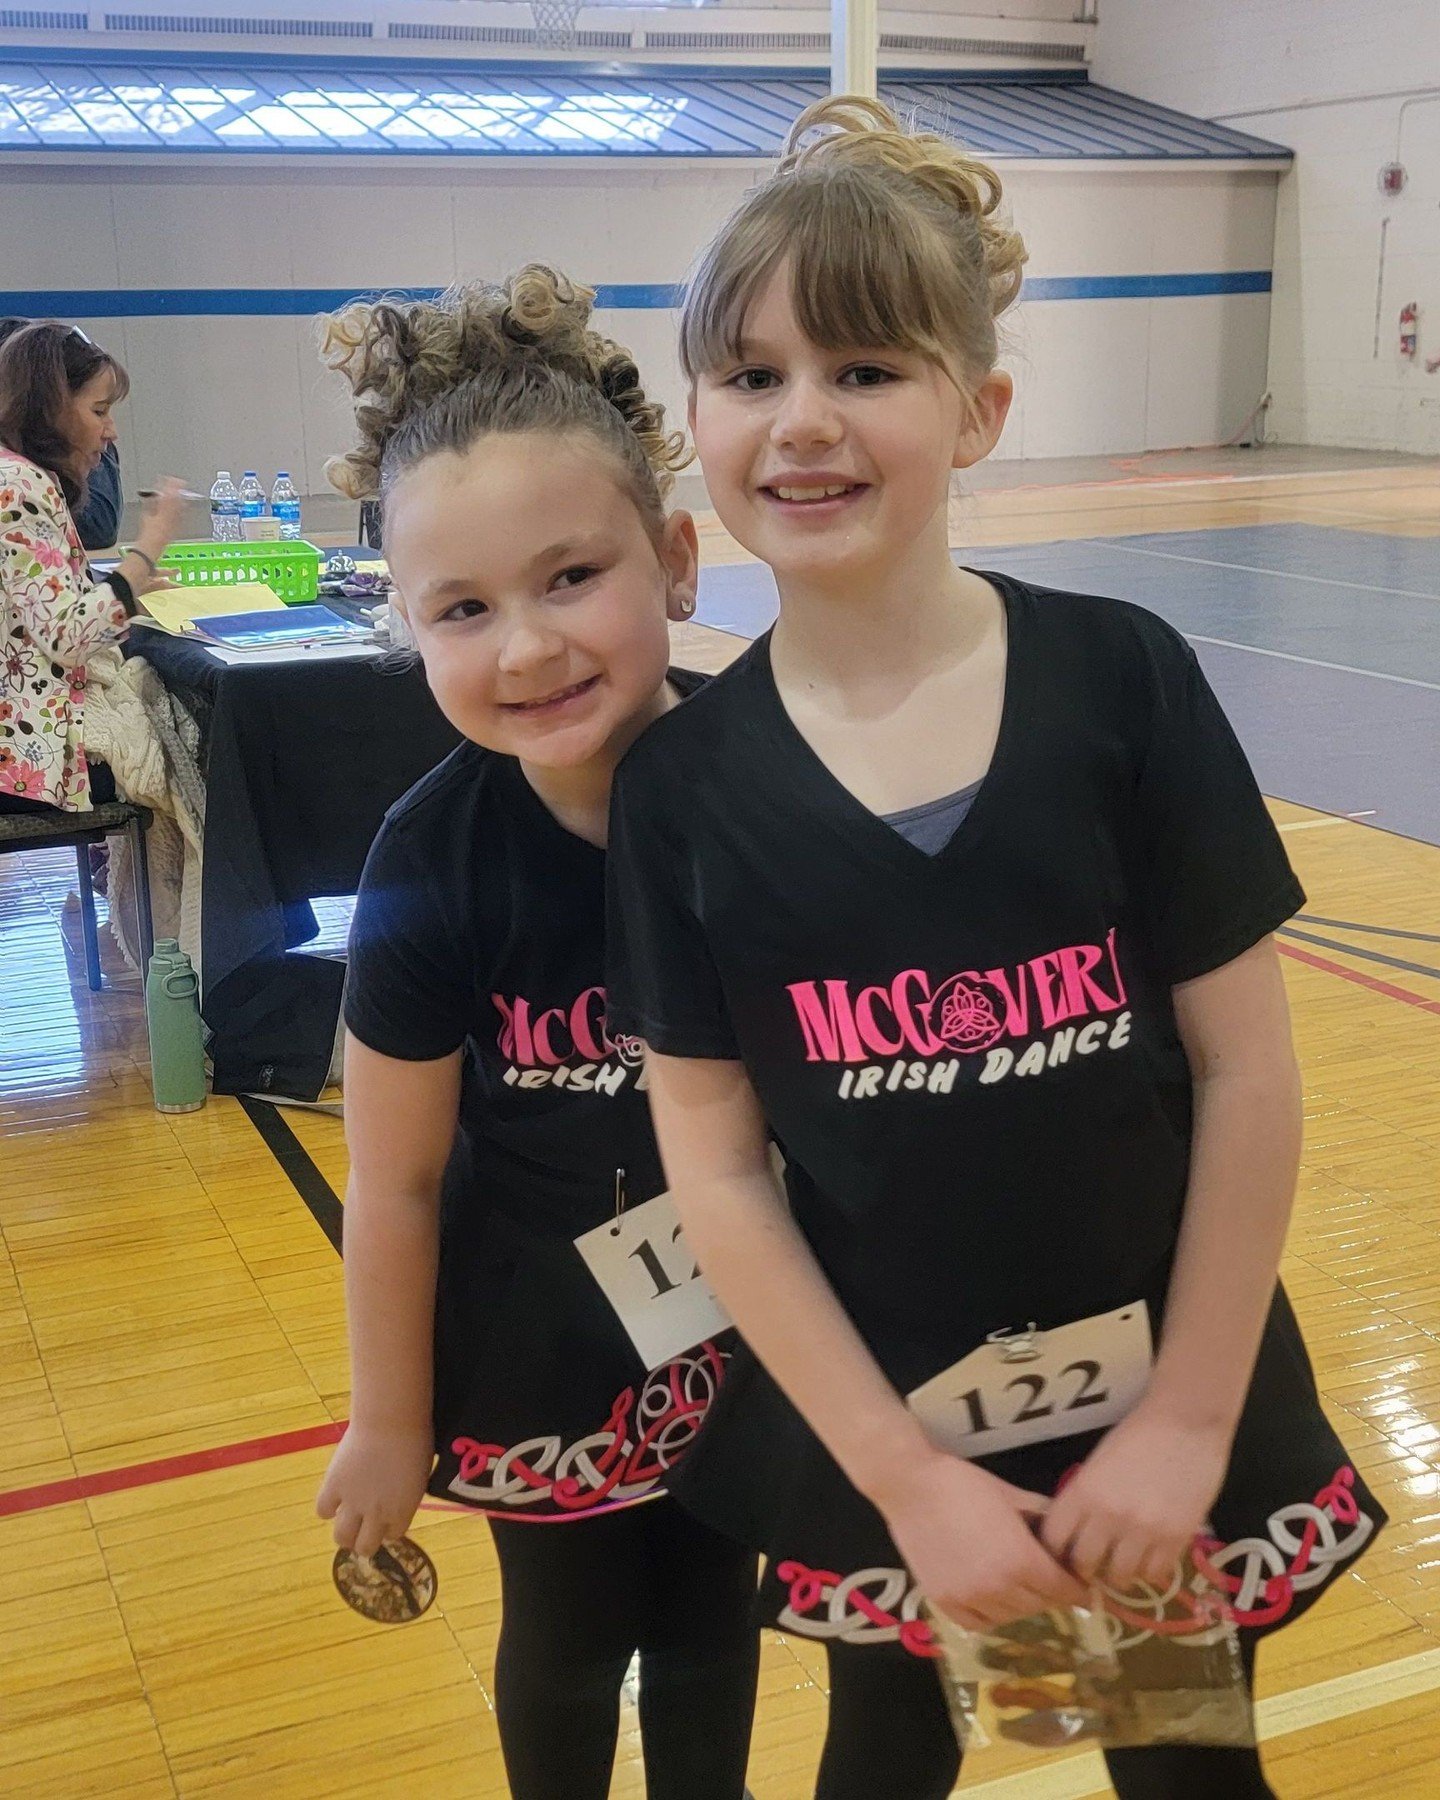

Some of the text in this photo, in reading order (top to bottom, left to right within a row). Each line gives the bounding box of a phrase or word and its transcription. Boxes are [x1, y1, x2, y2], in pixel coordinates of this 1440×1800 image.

[502, 1062, 627, 1097] IRISH
[838, 1011, 1133, 1100] IRISH DANCE
[953, 1359, 1110, 1436] 122
